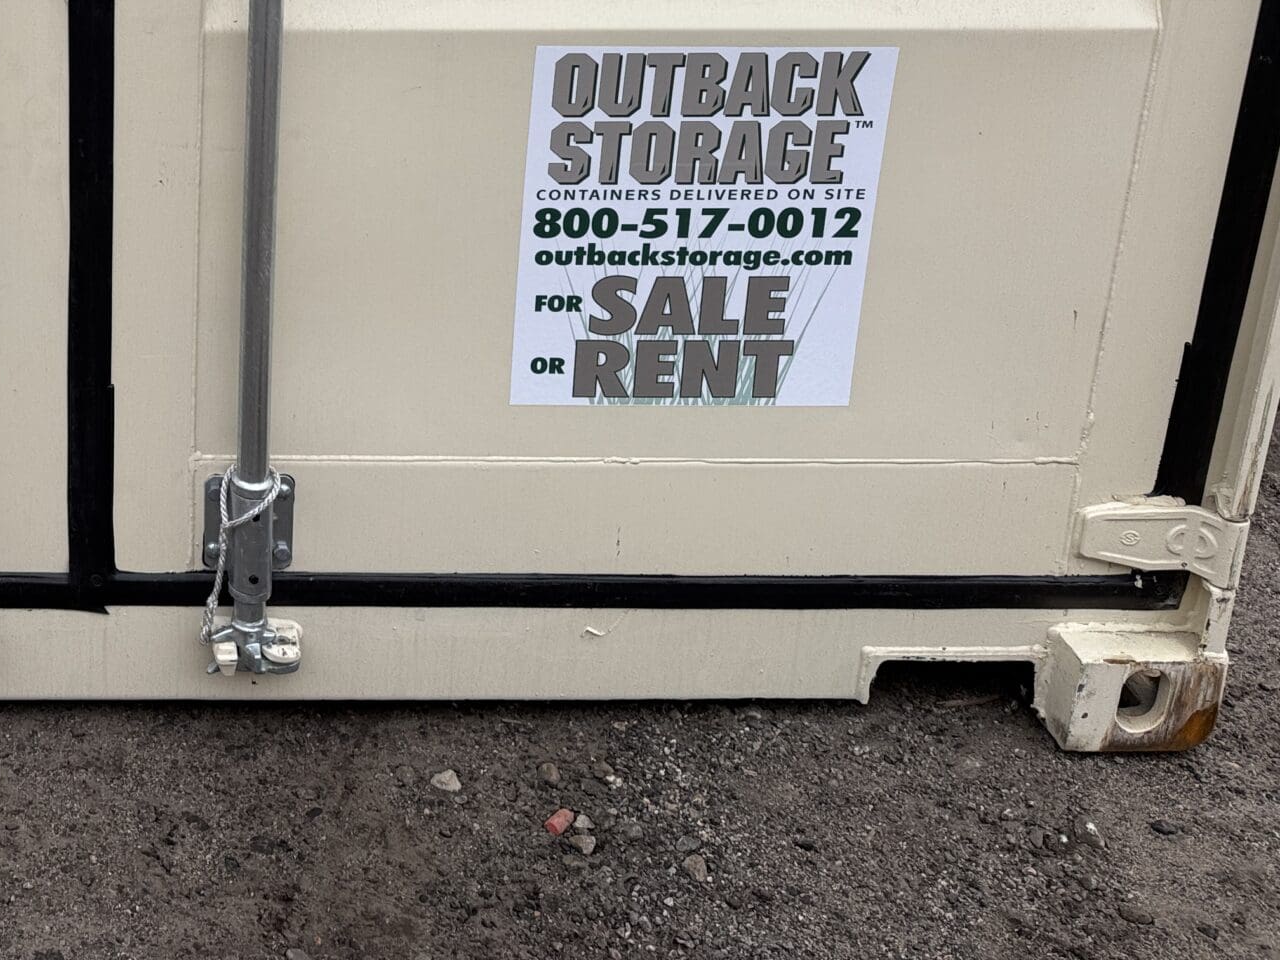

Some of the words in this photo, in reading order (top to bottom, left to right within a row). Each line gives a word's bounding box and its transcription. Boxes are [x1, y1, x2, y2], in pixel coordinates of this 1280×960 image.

[551, 51, 872, 117] OUTBACK
[547, 119, 849, 185] STORAGE
[533, 207, 862, 239] 800-517-0012
[536, 189, 661, 201] CONTAINERS
[669, 189, 778, 201] DELIVERED
[787, 189, 815, 200] ON
[824, 188, 866, 200] SITE
[534, 244, 853, 270] outbackstorage.com
[534, 295, 583, 312] FOR
[588, 275, 790, 336] SALE
[530, 357, 565, 375] OR
[572, 339, 794, 398] RENT
